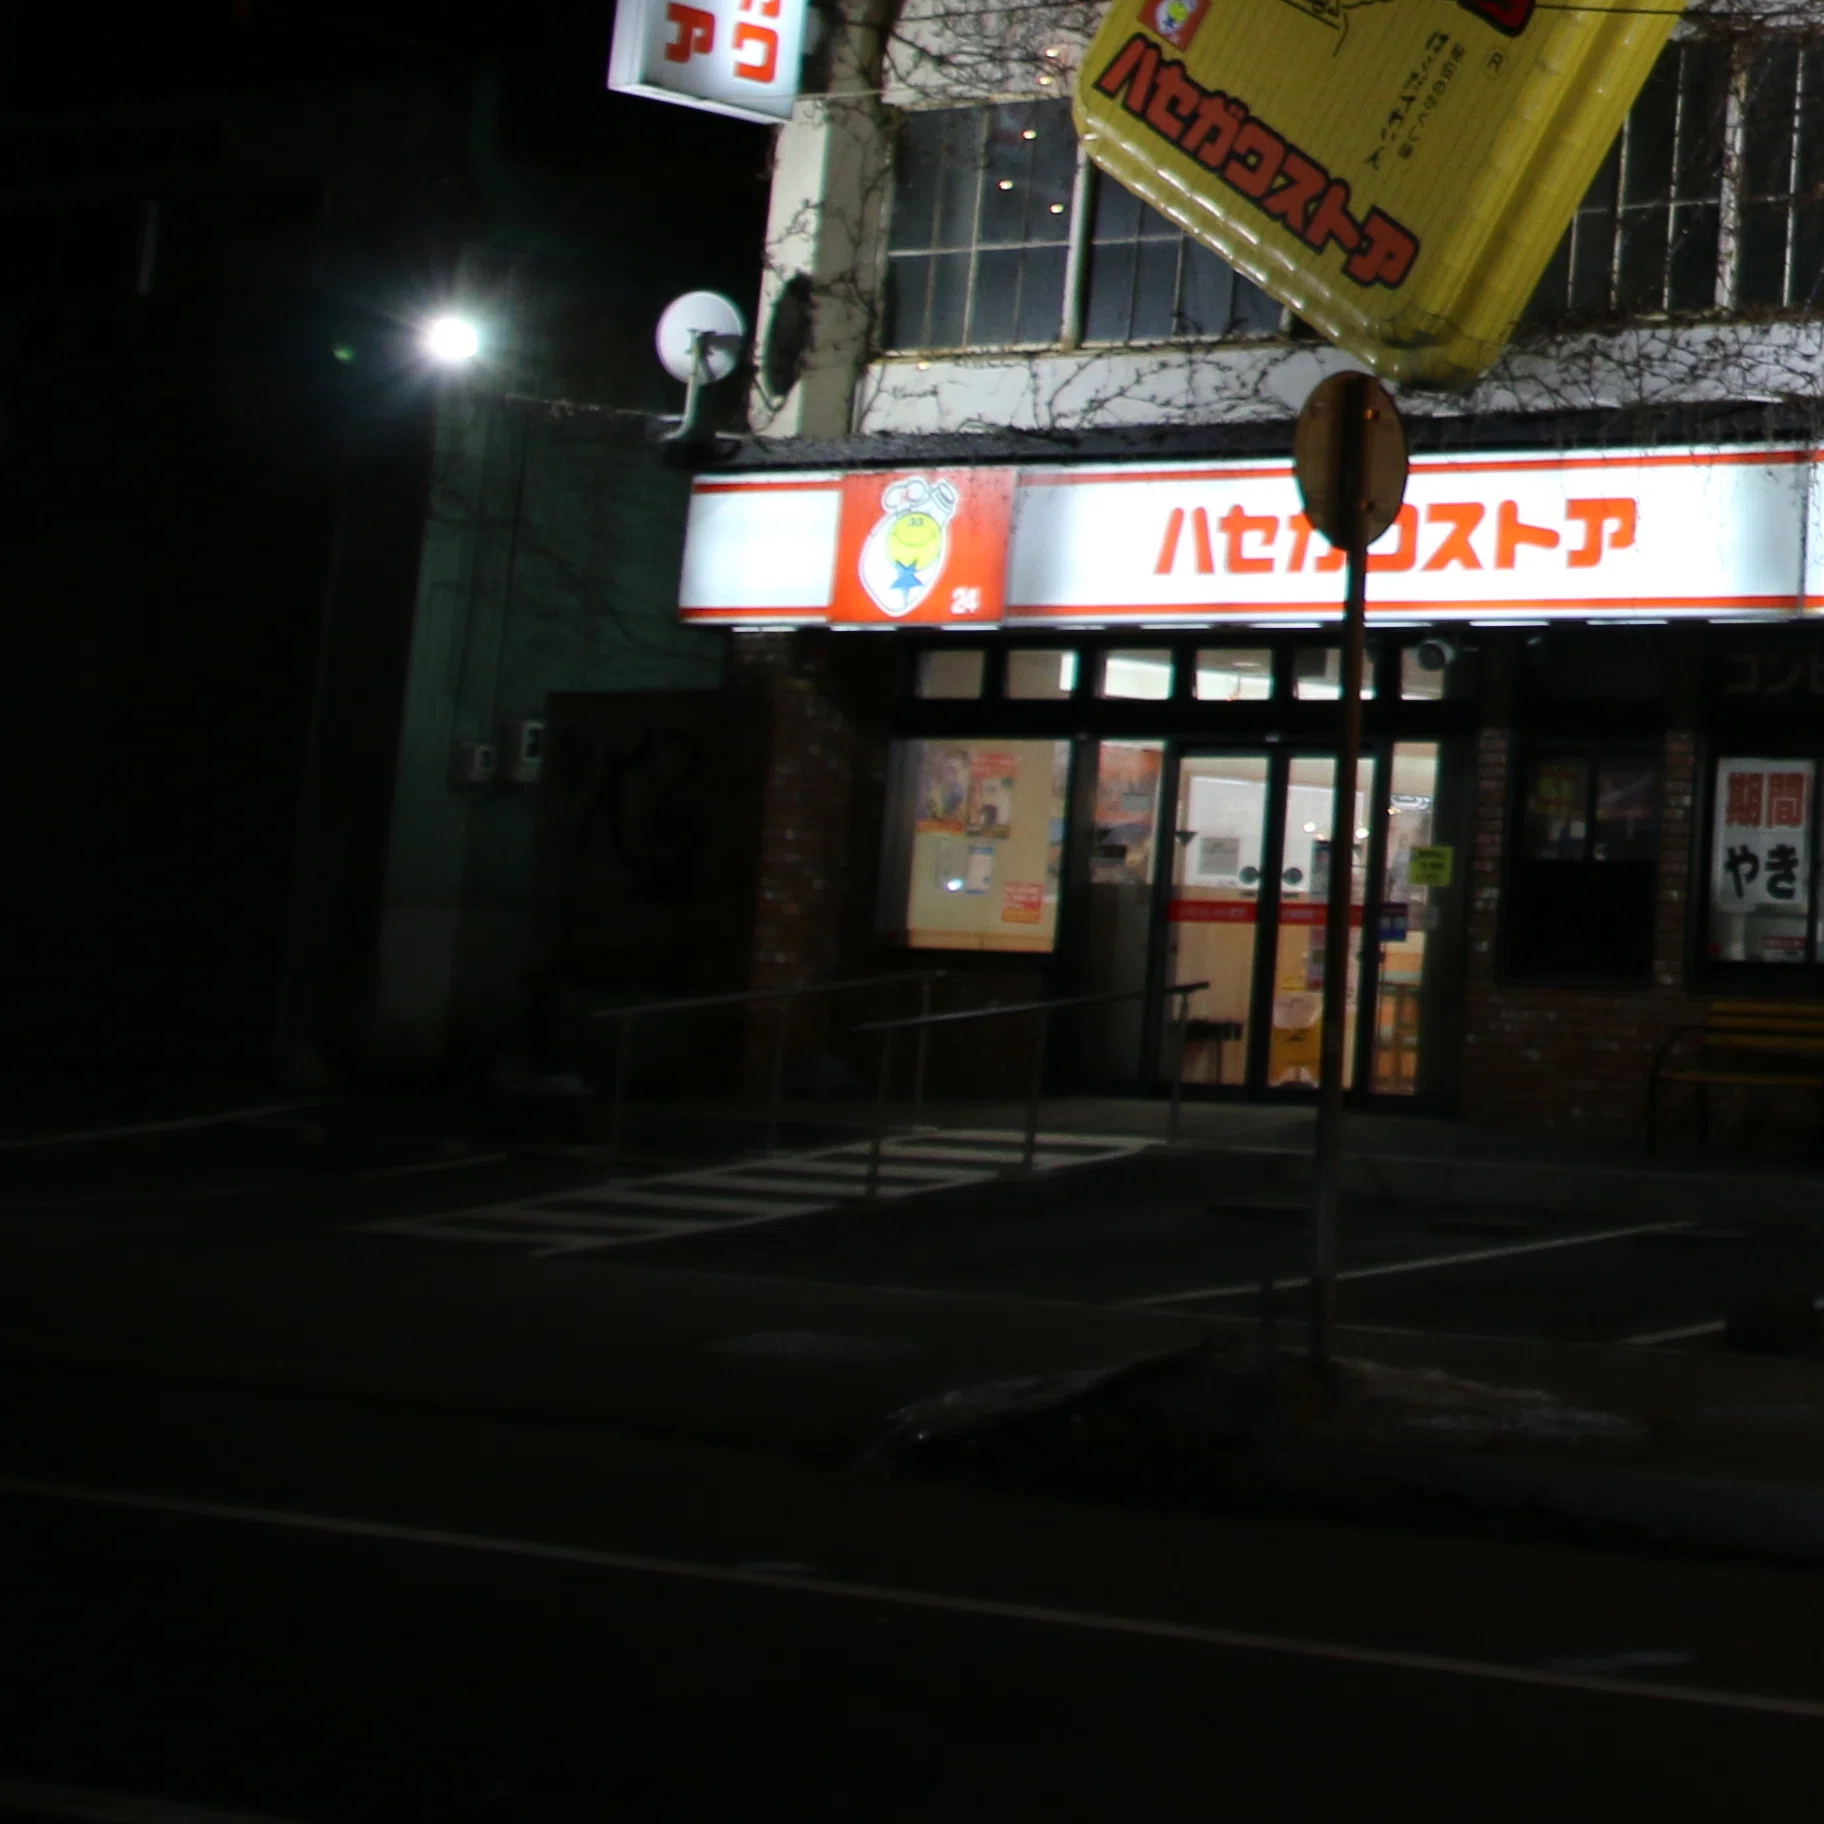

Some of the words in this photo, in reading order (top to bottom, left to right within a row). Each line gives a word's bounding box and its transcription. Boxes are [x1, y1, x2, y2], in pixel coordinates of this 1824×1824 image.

[1092, 32, 1420, 288] ハセガワストア
[950, 587, 981, 616] 24
